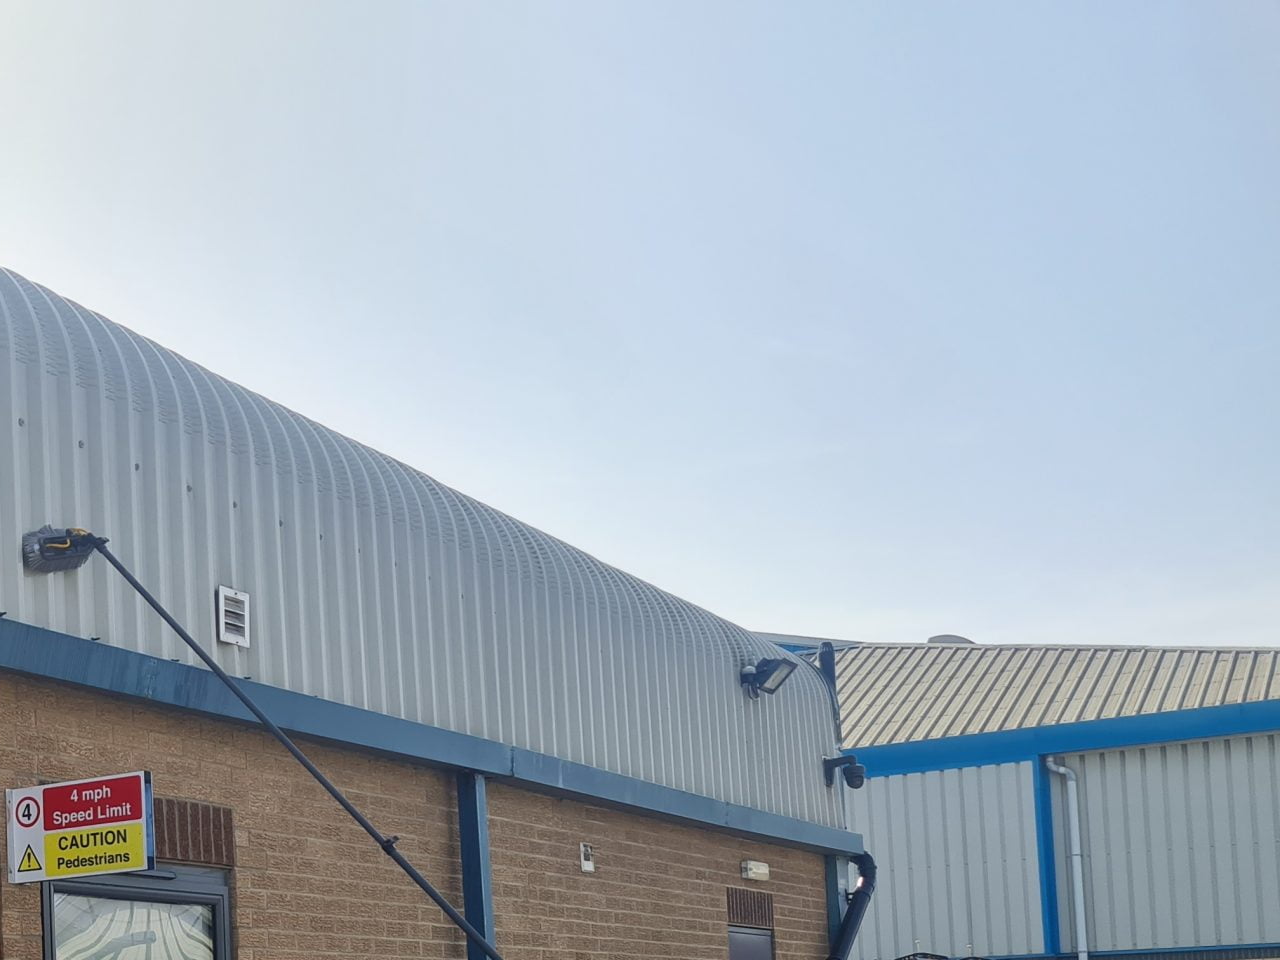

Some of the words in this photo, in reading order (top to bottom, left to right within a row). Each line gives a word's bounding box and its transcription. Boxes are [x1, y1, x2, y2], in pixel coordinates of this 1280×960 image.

[70, 789, 79, 802] 4
[82, 785, 111, 803] mph
[21, 803, 32, 821] 4
[53, 807, 93, 828] Speed
[97, 802, 132, 819] Limit
[58, 828, 127, 851] CAUTION
[57, 851, 130, 870] Pedestrians
